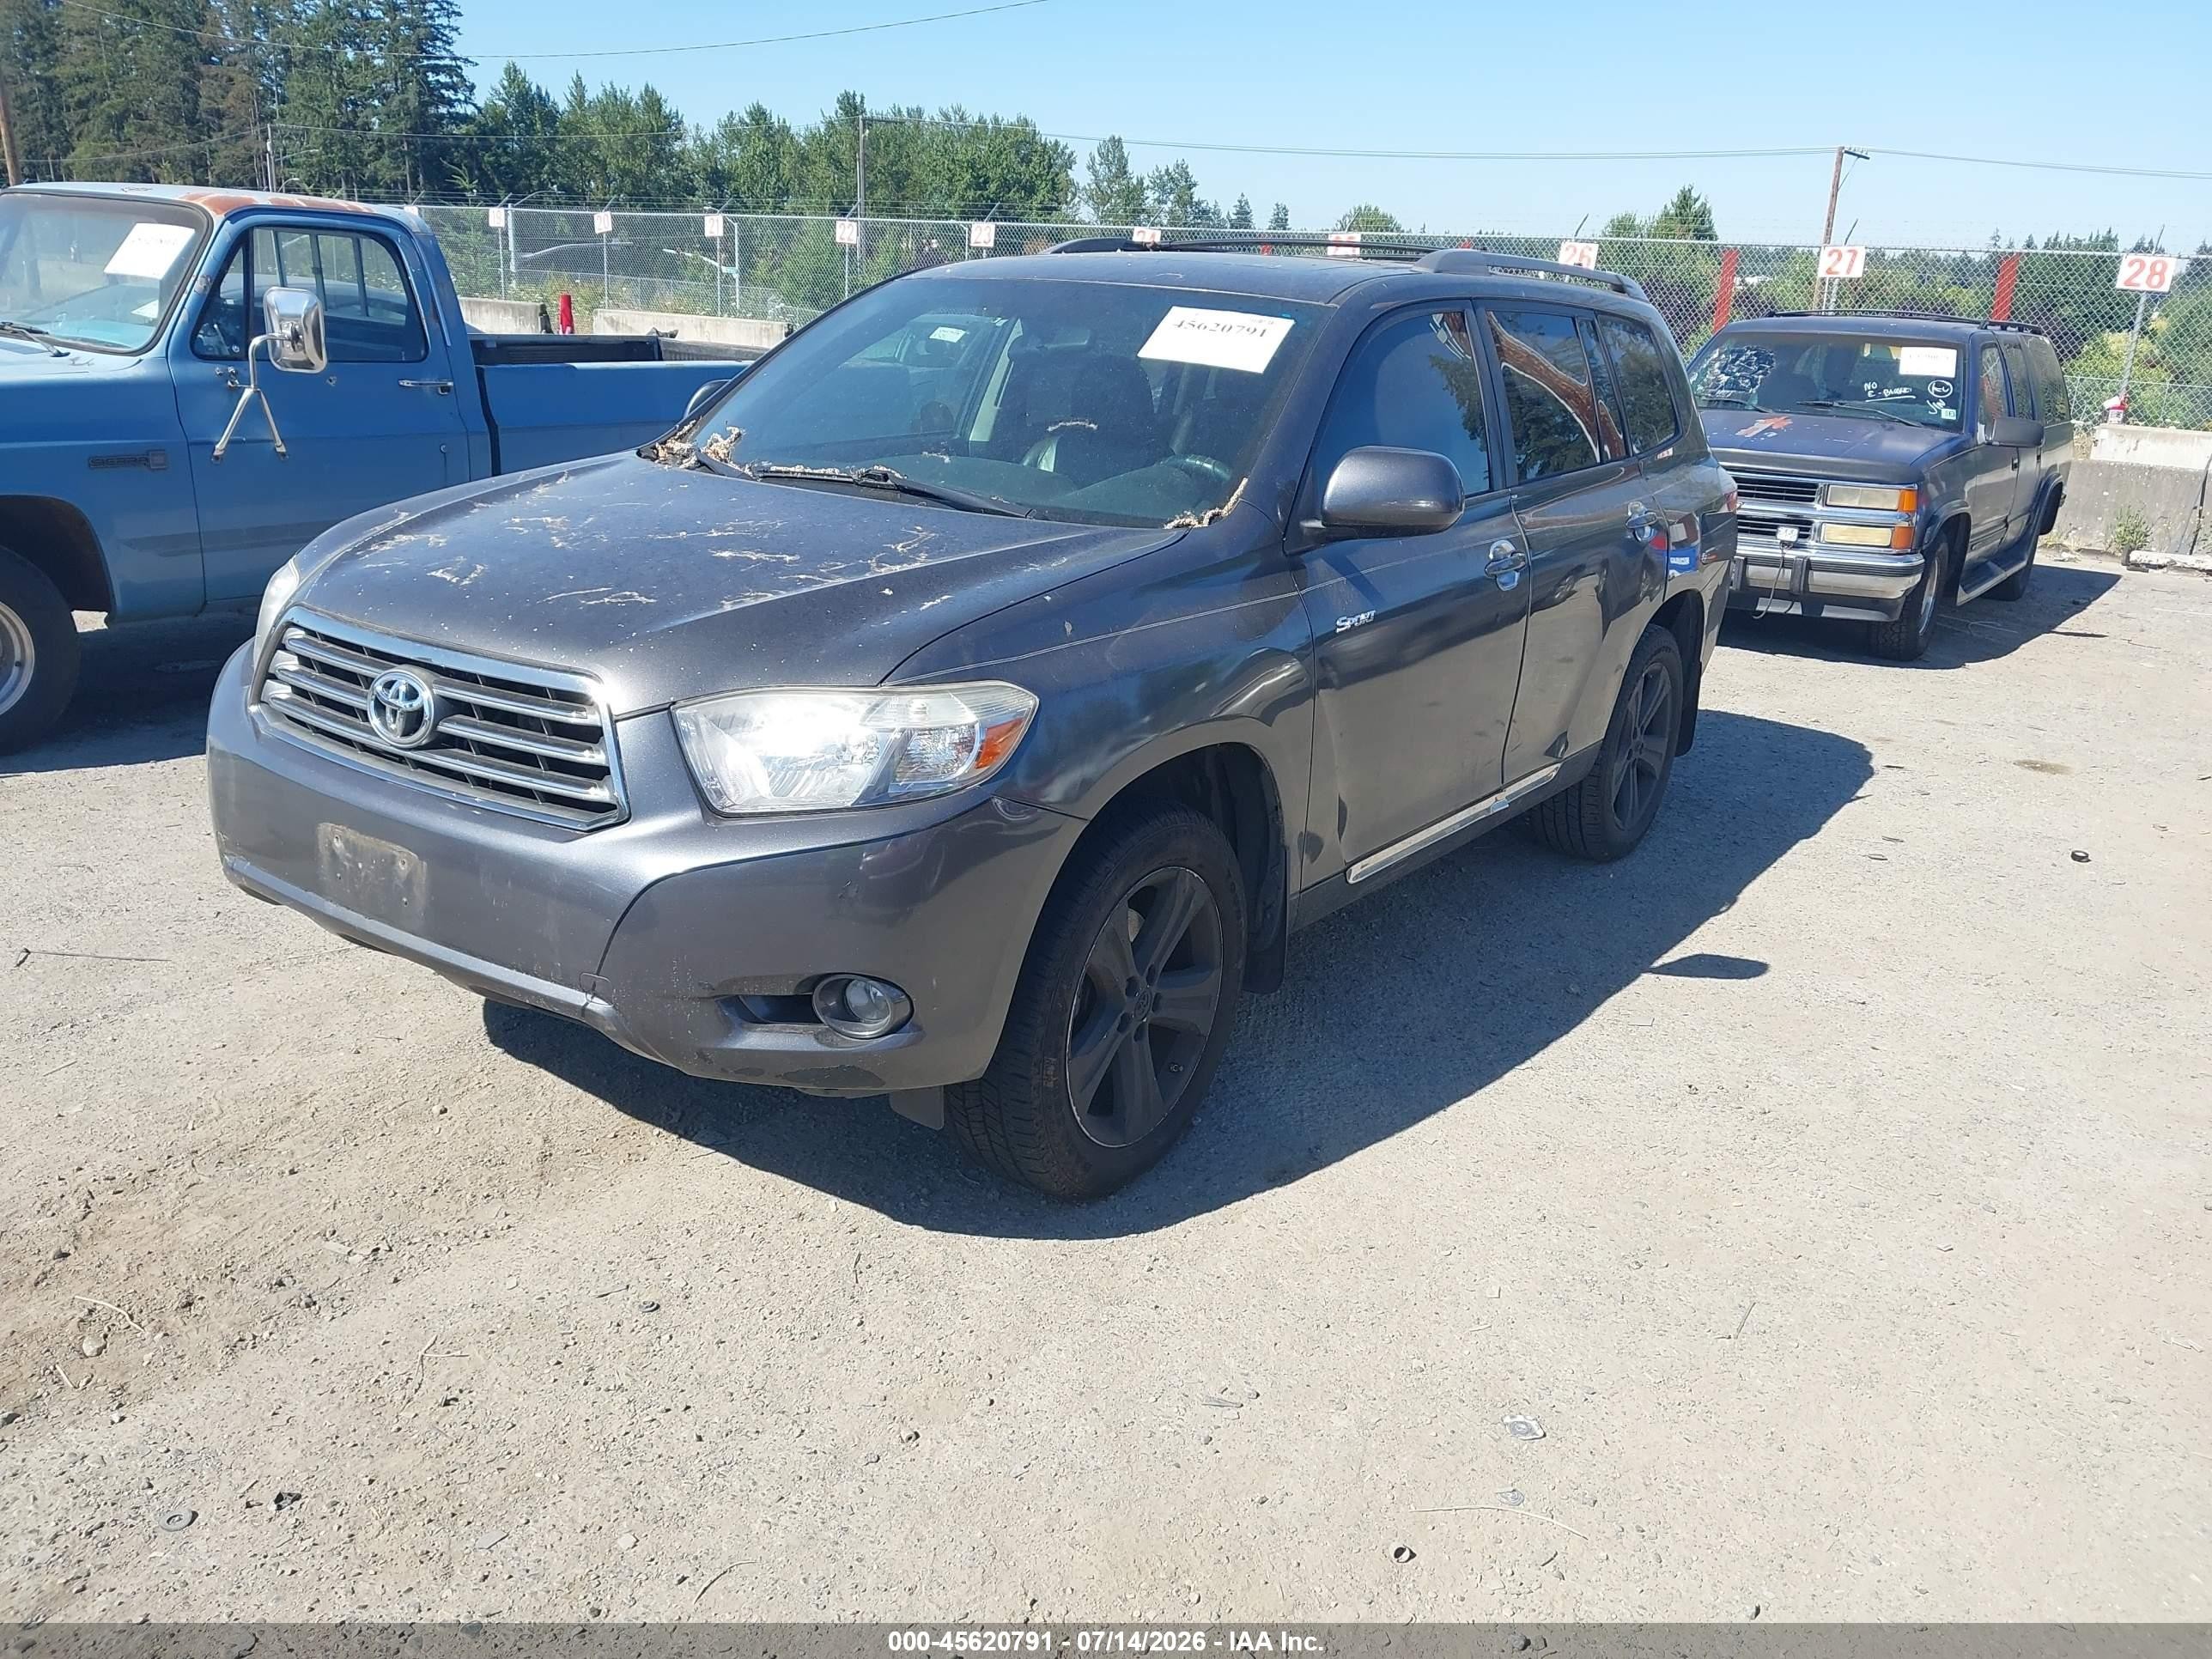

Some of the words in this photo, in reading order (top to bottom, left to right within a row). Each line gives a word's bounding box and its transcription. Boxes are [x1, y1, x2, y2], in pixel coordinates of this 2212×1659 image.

[708, 217, 720, 234] 21
[839, 222, 854, 241] 22
[974, 225, 992, 245] 23
[1565, 244, 1593, 267] 26
[1826, 248, 1858, 275] 27
[2123, 258, 2168, 289] 28
[1173, 319, 1267, 337] 45620791
[1863, 381, 1877, 392] NO
